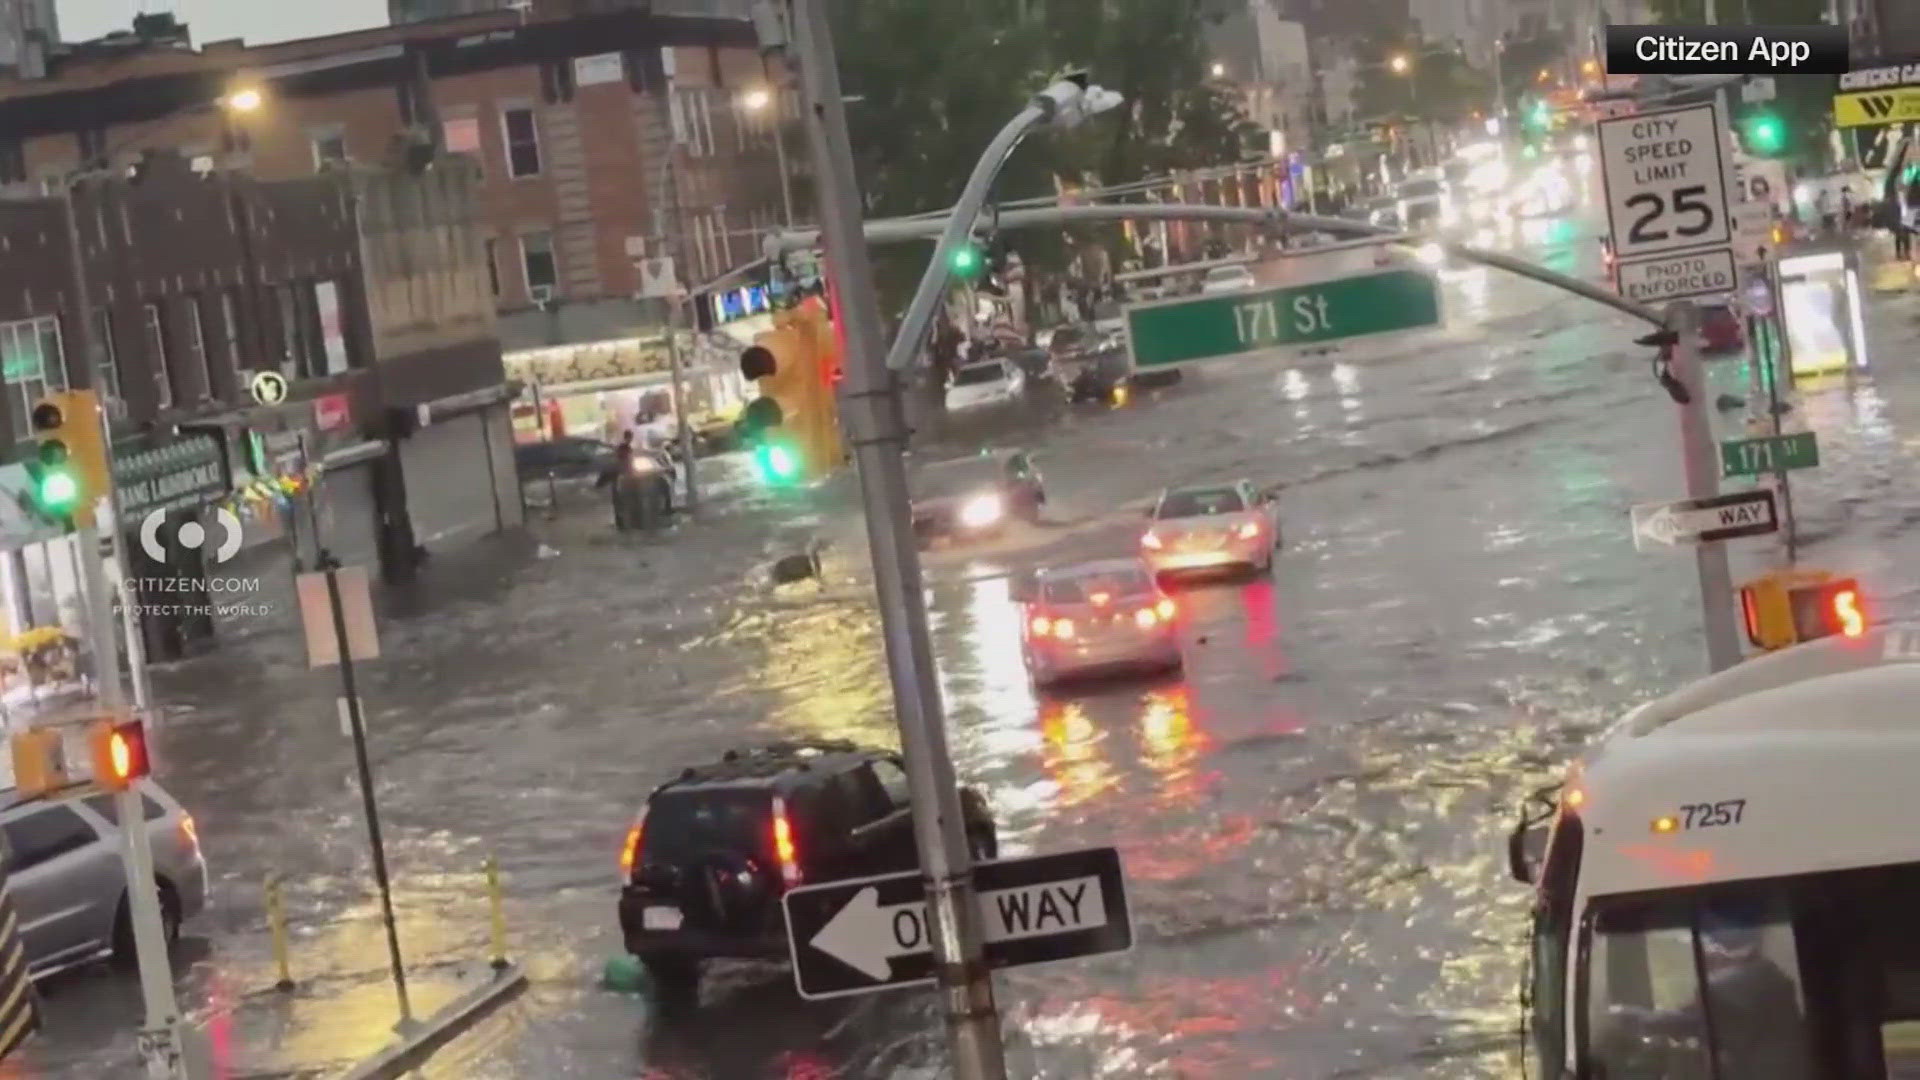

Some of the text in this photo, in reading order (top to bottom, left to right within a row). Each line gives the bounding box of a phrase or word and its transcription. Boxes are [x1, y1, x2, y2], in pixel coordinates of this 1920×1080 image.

[1632, 119, 1678, 139] CITY
[1624, 139, 1692, 163] SPEED
[1634, 162, 1688, 184] LIMIT
[1624, 184, 1714, 243] 25
[1646, 260, 1706, 279] PHOTO
[1628, 272, 1727, 298] ENFORCED
[1232, 293, 1332, 343] 171 St
[1739, 442, 1773, 470] 171
[1718, 502, 1762, 526] WAY
[1680, 798, 1746, 830] 7257
[997, 883, 1087, 934] WAY
